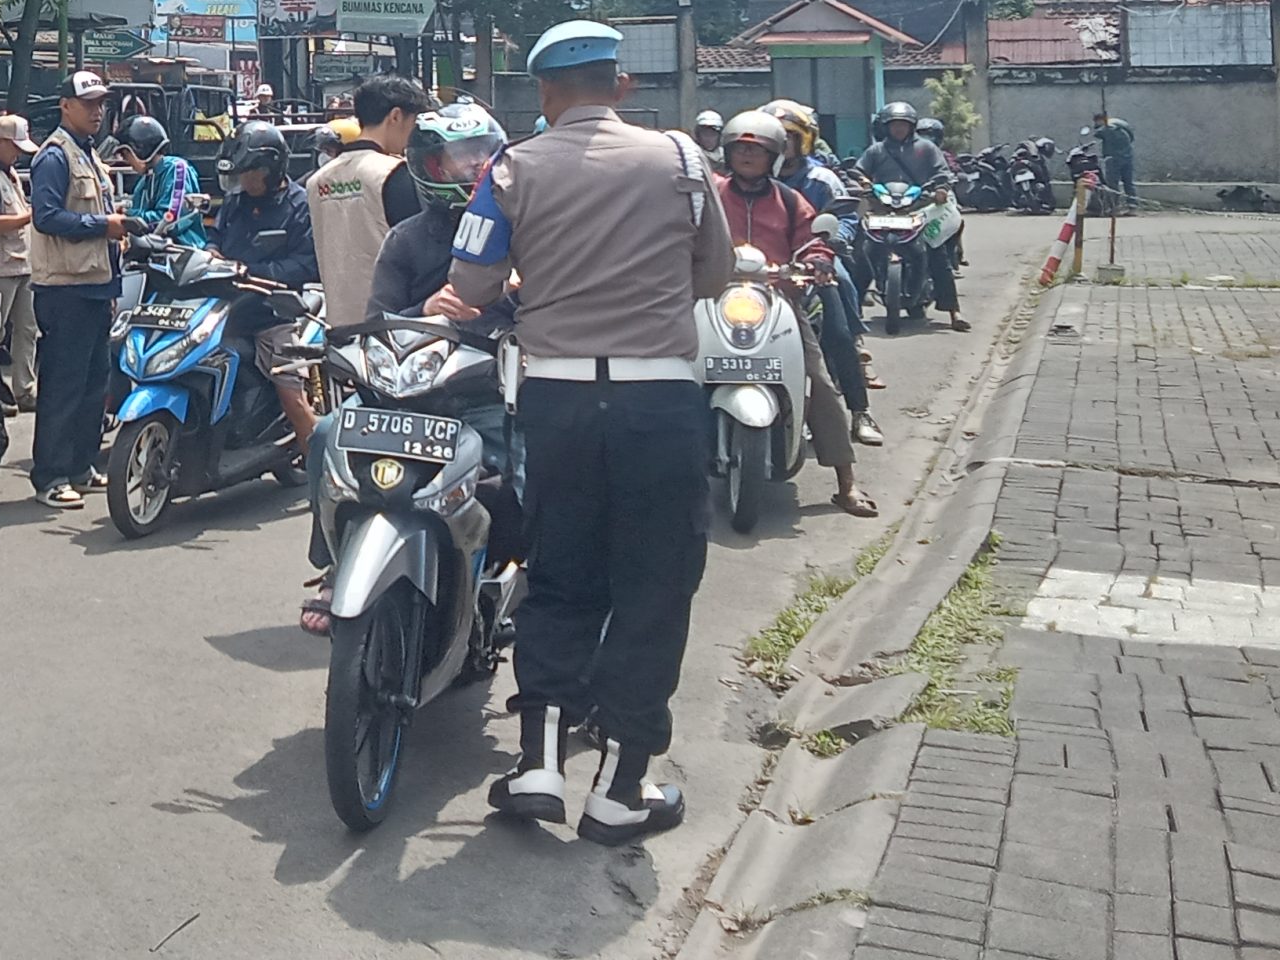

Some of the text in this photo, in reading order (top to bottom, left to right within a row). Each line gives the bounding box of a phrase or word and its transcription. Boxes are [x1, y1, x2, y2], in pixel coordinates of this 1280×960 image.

[342, 1, 425, 15] BUMIMAS KENCANA
[706, 358, 782, 370] D 5313 JE
[344, 410, 457, 441] D 5706 VCP
